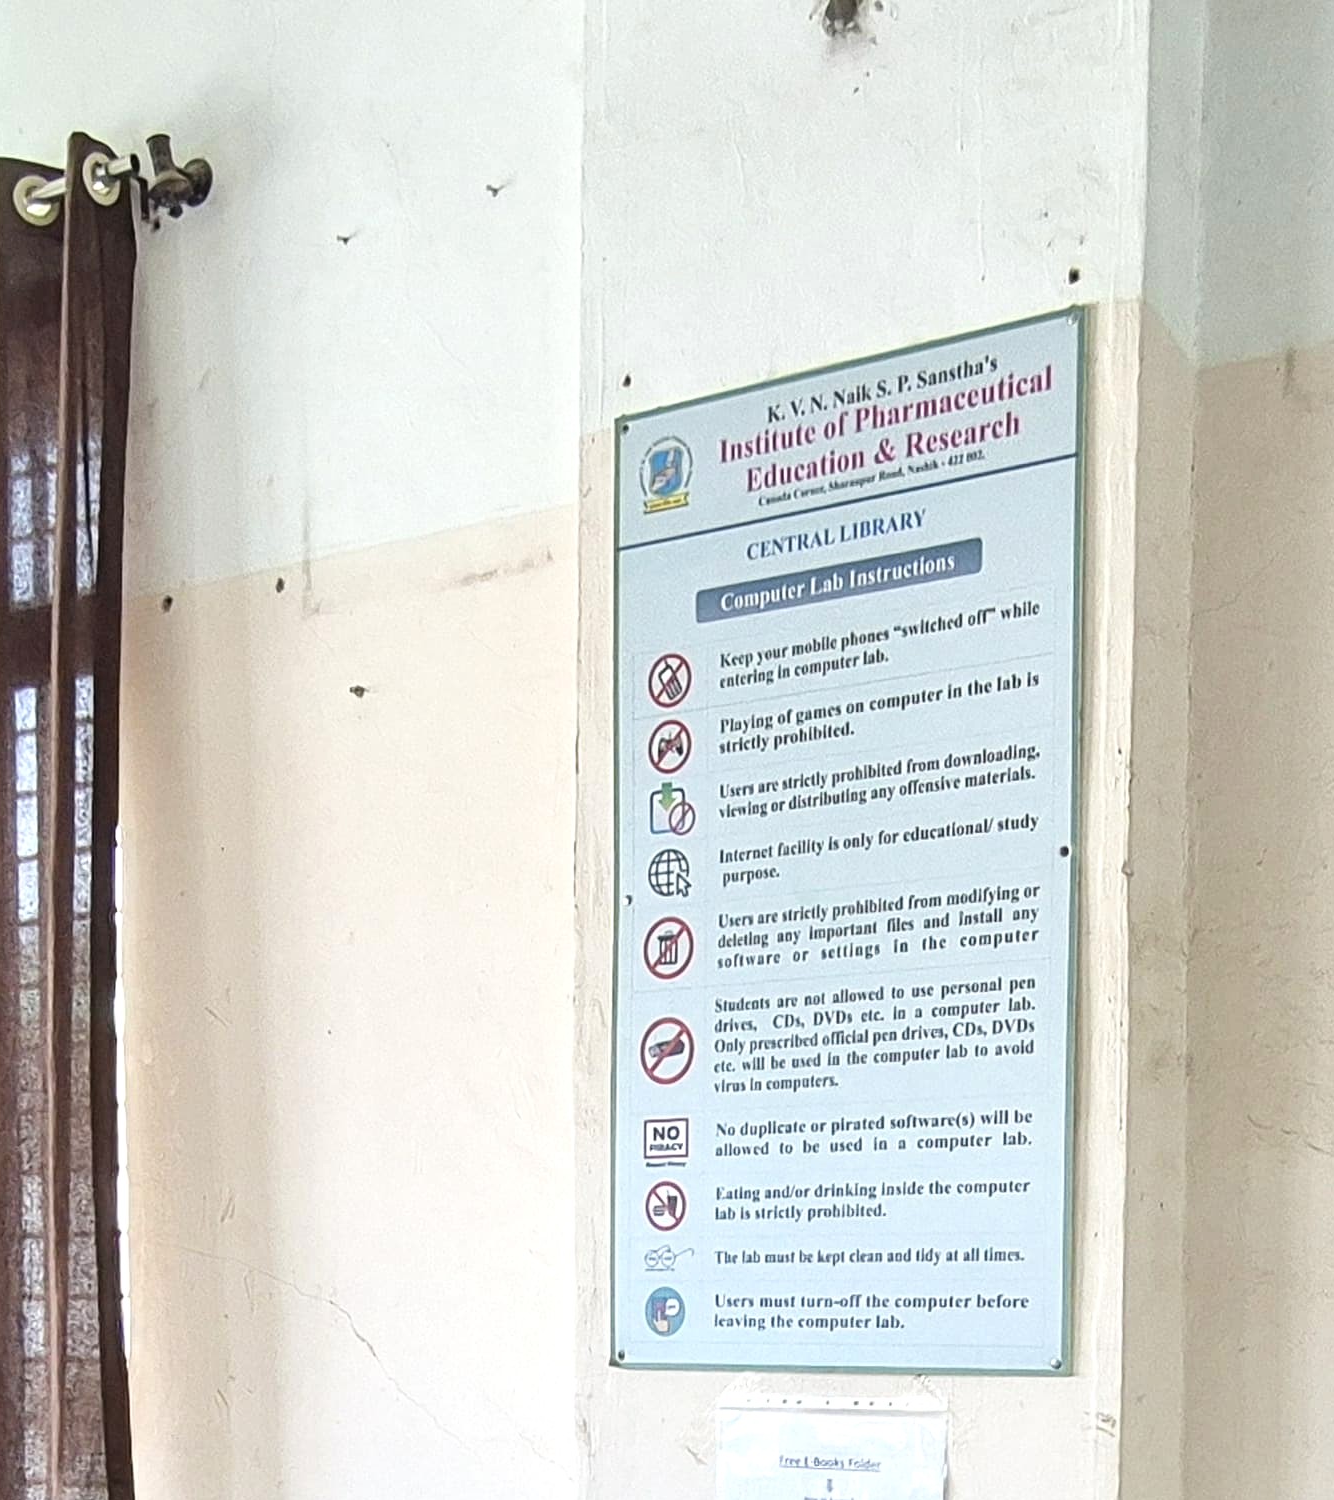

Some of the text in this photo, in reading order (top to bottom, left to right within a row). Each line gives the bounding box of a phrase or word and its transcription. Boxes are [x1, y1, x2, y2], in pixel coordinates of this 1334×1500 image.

[721, 364, 1051, 464] Institute of Pharmaceutical
[767, 403, 785, 424] K.
[790, 397, 805, 417] V.
[810, 394, 827, 414] N.
[833, 383, 872, 409] Naik
[876, 379, 892, 399] S.
[897, 374, 911, 394] P.
[747, 410, 1019, 493] Education & Research
[746, 508, 926, 560] CENTRAL LIBRARY
[721, 555, 955, 611] Computer Lab Instructions
[720, 652, 753, 668] Keep
[756, 646, 789, 666] your
[791, 635, 837, 657] mobile
[841, 629, 889, 652] phones
[1000, 600, 1040, 620] while
[719, 647, 889, 688] entering computer lab.
[720, 673, 1022, 734] Playing of games computer the lab
[718, 720, 854, 754] strictly prohibited.
[719, 783, 754, 799] Users
[757, 780, 779, 794] are
[782, 771, 828, 790] strictly
[831, 759, 902, 788] prohibited
[906, 758, 940, 774] from
[719, 765, 1035, 818] viewing distributing any offensive materials.
[719, 845, 773, 864] Internet
[777, 838, 824, 857] facility
[843, 832, 873, 851] only
[878, 829, 899, 845] for
[997, 813, 1039, 832] study
[722, 867, 779, 888] purpose.
[718, 885, 1020, 929] Users are strictly prohibited from modifying
[717, 907, 1039, 948] deleting any important files and install any
[717, 929, 1039, 968] software settings the computer
[714, 976, 1035, 1013] Students are not allowed use personal pen
[714, 996, 1035, 1033] drives, CDs, DVDs etc. computer lab.
[714, 1018, 1035, 1055] Only prescribed official pen drives, CDs, DVDs
[713, 1039, 1034, 1073] etc. will used the computer lab avoid
[714, 1075, 838, 1093] virus computers.
[652, 1125, 680, 1142] NO
[716, 1109, 1008, 1138] No duplicate pirated software(s) will
[715, 1131, 1032, 1156] allowed used computer lab.
[716, 1180, 1030, 1203] Eating and/or drinking inside the computer
[715, 1203, 886, 1222] lab strictly prohibited.
[714, 1247, 1025, 1266] The lab must kept clean and tidy times.
[715, 1293, 1029, 1312] Users must turn-off the computer before
[714, 1313, 904, 1332] leaving the computer lab.
